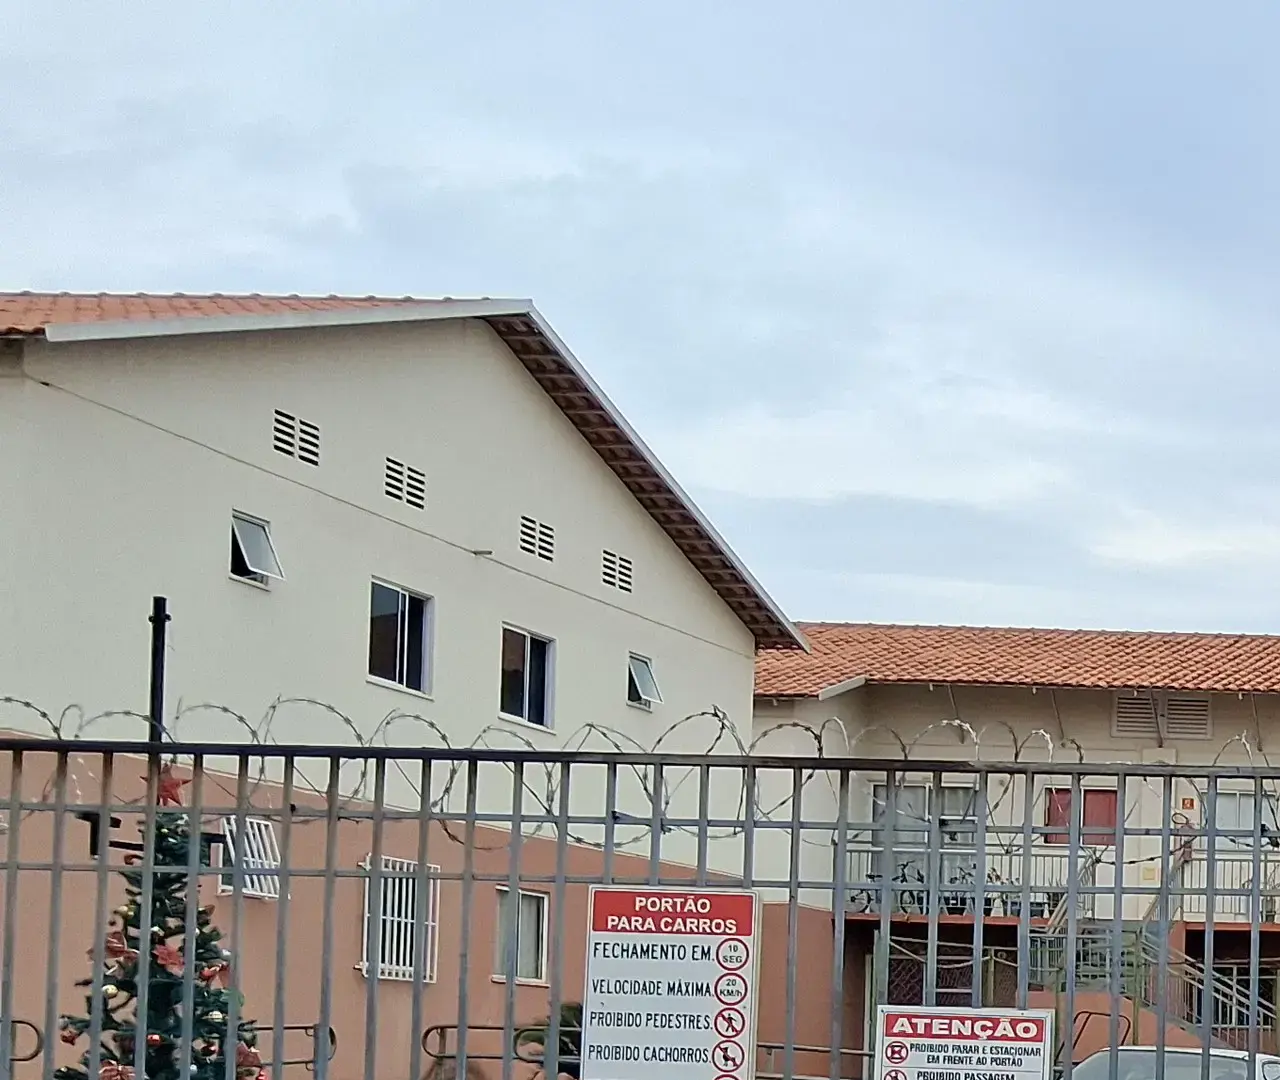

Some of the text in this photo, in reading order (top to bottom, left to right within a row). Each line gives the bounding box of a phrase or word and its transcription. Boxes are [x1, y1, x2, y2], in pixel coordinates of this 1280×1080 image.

[635, 894, 711, 914] PORTÃO
[607, 916, 737, 934] PARA CARROS
[593, 942, 687, 961] FECHAMENTO
[728, 944, 739, 953] 10
[722, 954, 743, 964] SEG
[592, 979, 715, 997] VELOCIDADE MÁXIMA.
[719, 988, 743, 997] KM/h
[726, 979, 737, 988] 20
[590, 1011, 713, 1030] PROIBIDO PEDESTRES.
[891, 1018, 1038, 1040] ATENÇÃO
[588, 1044, 711, 1064] PROIBIDO CACHORROS.
[909, 1043, 1041, 1057] PROIBIDO PARAR E ESTACIONAR
[926, 1055, 1023, 1067] EM FRENTE AO PORTÃO
